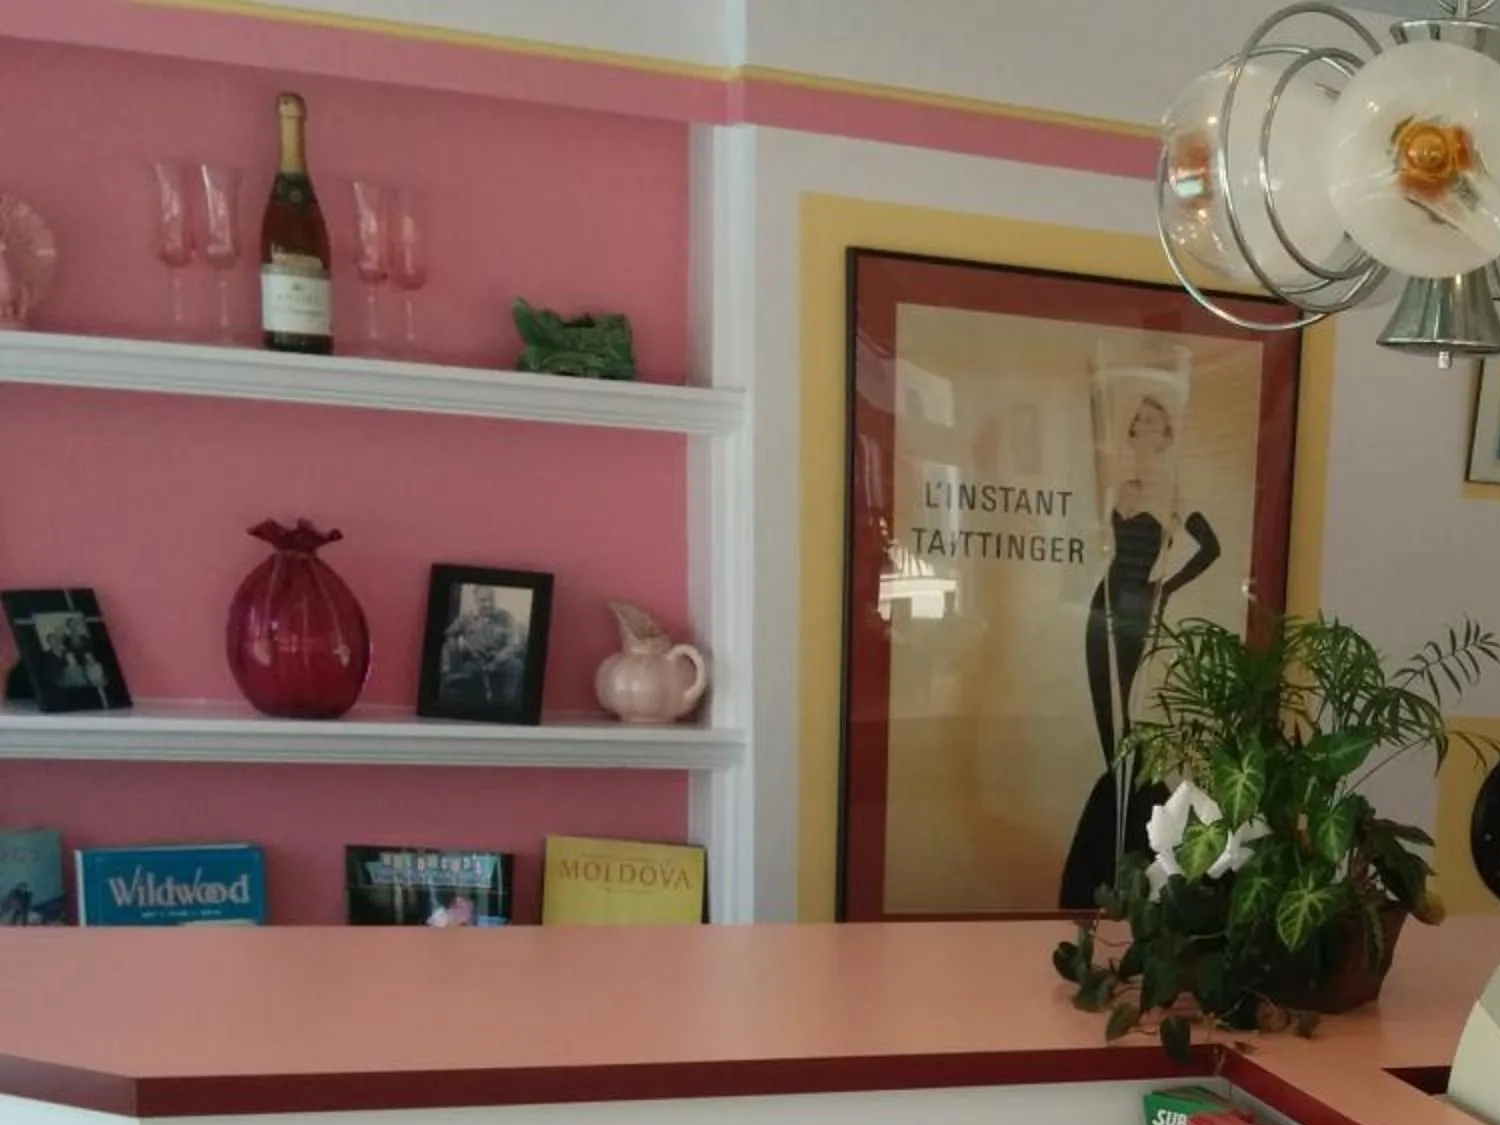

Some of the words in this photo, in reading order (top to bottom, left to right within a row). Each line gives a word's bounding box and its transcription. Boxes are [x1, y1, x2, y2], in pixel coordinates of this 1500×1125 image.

[925, 481, 1073, 518] L'INSTANT
[911, 527, 1084, 564] TAITTINGER
[107, 865, 251, 907] Wildwood
[558, 858, 692, 891] MOLDOVA
